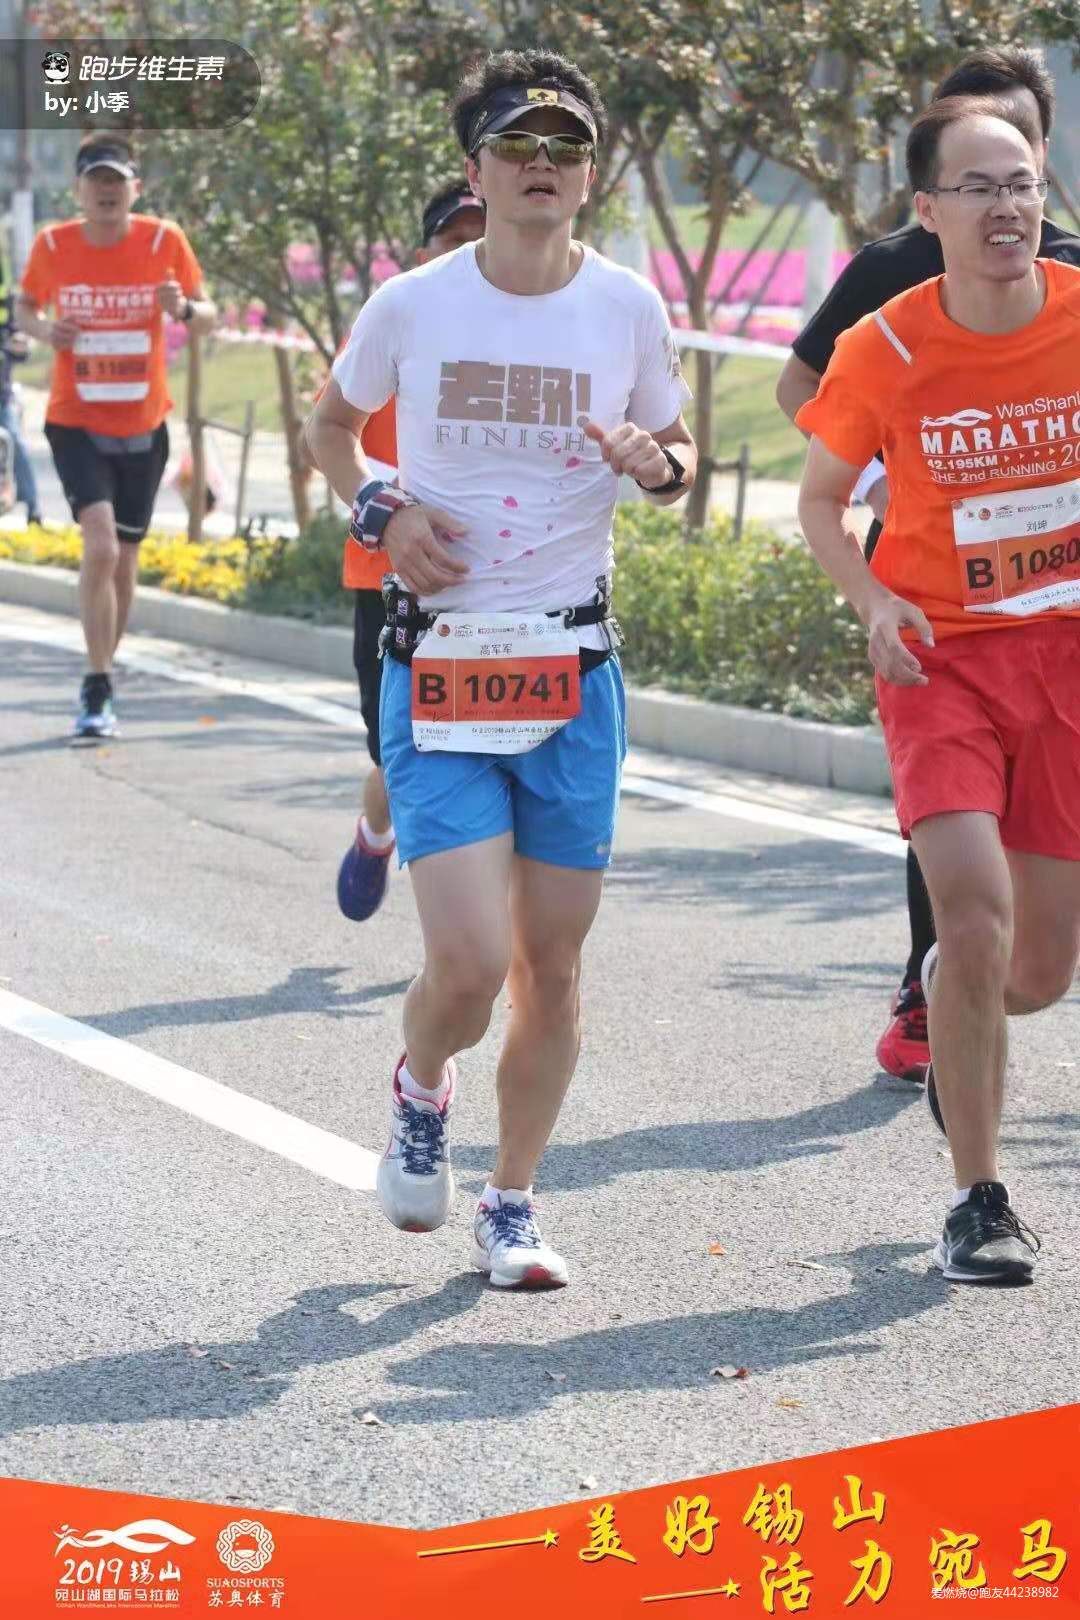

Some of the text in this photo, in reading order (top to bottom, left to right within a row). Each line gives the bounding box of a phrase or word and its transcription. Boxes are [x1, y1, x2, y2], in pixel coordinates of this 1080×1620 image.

[434, 424, 586, 452] FINISH
[927, 454, 998, 470] 42.195KM
[931, 460, 1057, 483] THE 2nd RUNNING
[966, 557, 995, 589] B
[419, 672, 569, 704] B 10741
